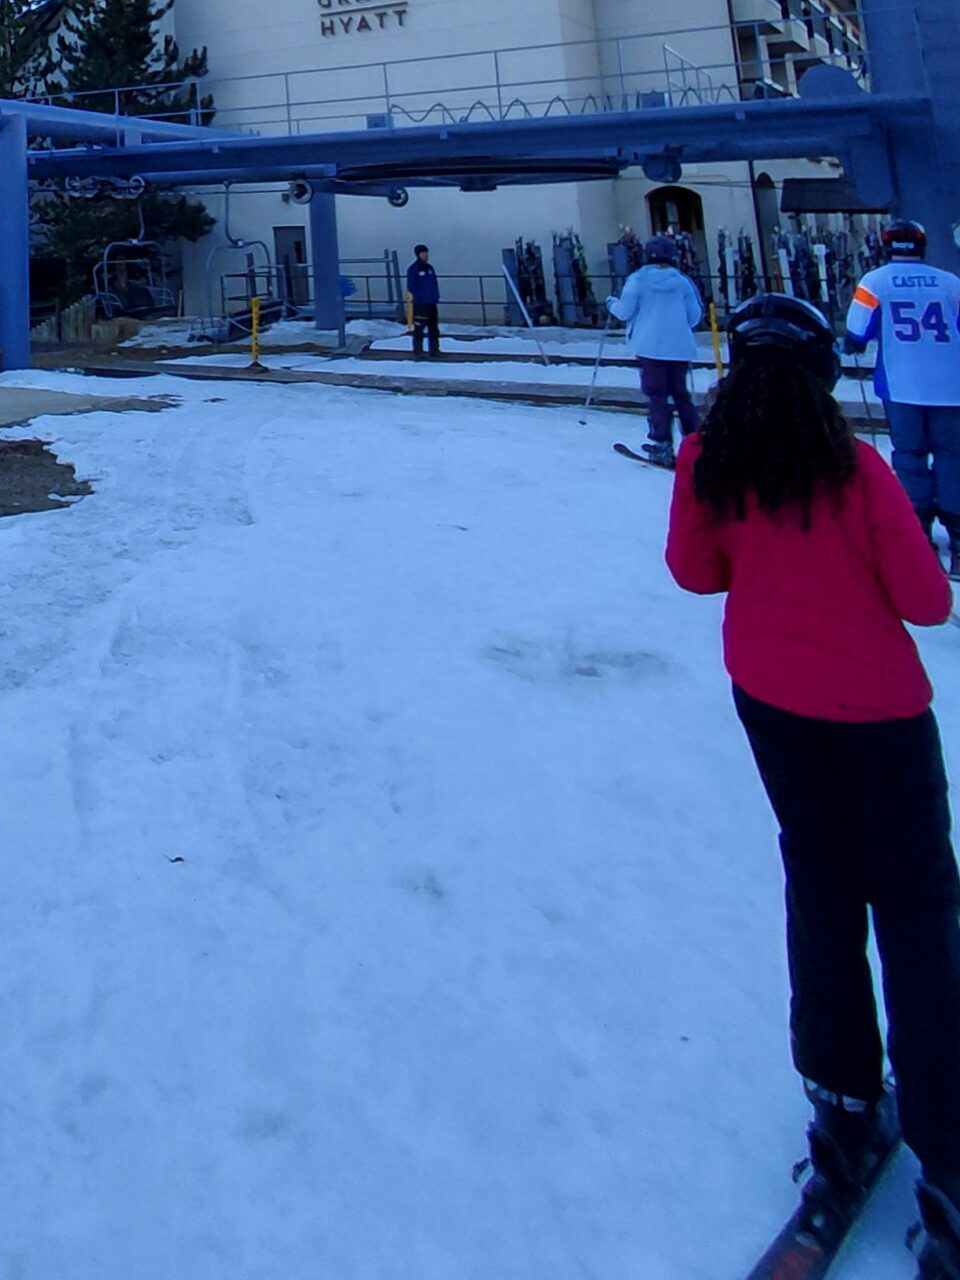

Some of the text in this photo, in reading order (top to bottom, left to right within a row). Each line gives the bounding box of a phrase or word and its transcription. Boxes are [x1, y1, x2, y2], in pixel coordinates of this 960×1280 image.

[320, 9, 407, 37] HYATT
[892, 275, 939, 288] CASTLE
[889, 301, 951, 343] 54
